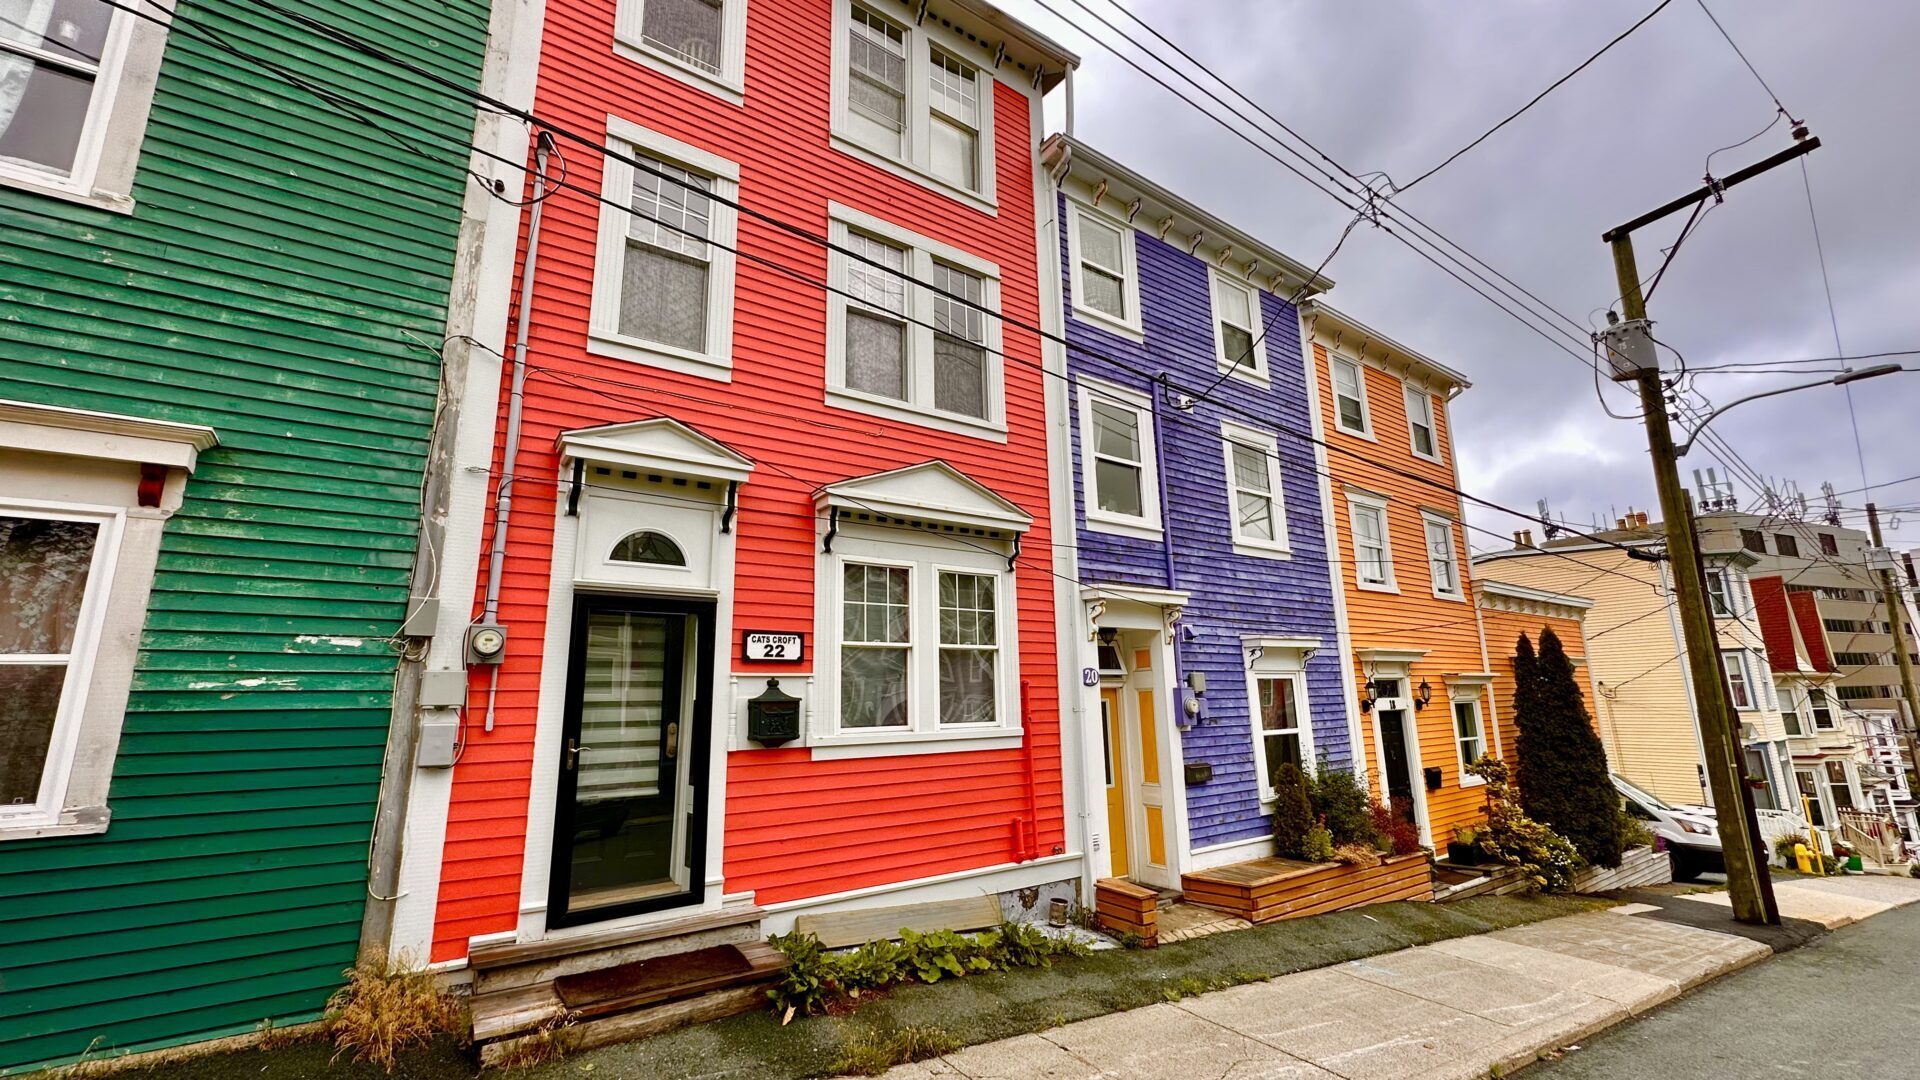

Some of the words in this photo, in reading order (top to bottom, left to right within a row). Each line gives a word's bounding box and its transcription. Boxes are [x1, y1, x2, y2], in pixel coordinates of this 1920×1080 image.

[751, 635, 771, 644] CATS
[772, 636, 797, 645] CROFT
[763, 644, 785, 658] 22
[1084, 669, 1098, 684] 20
